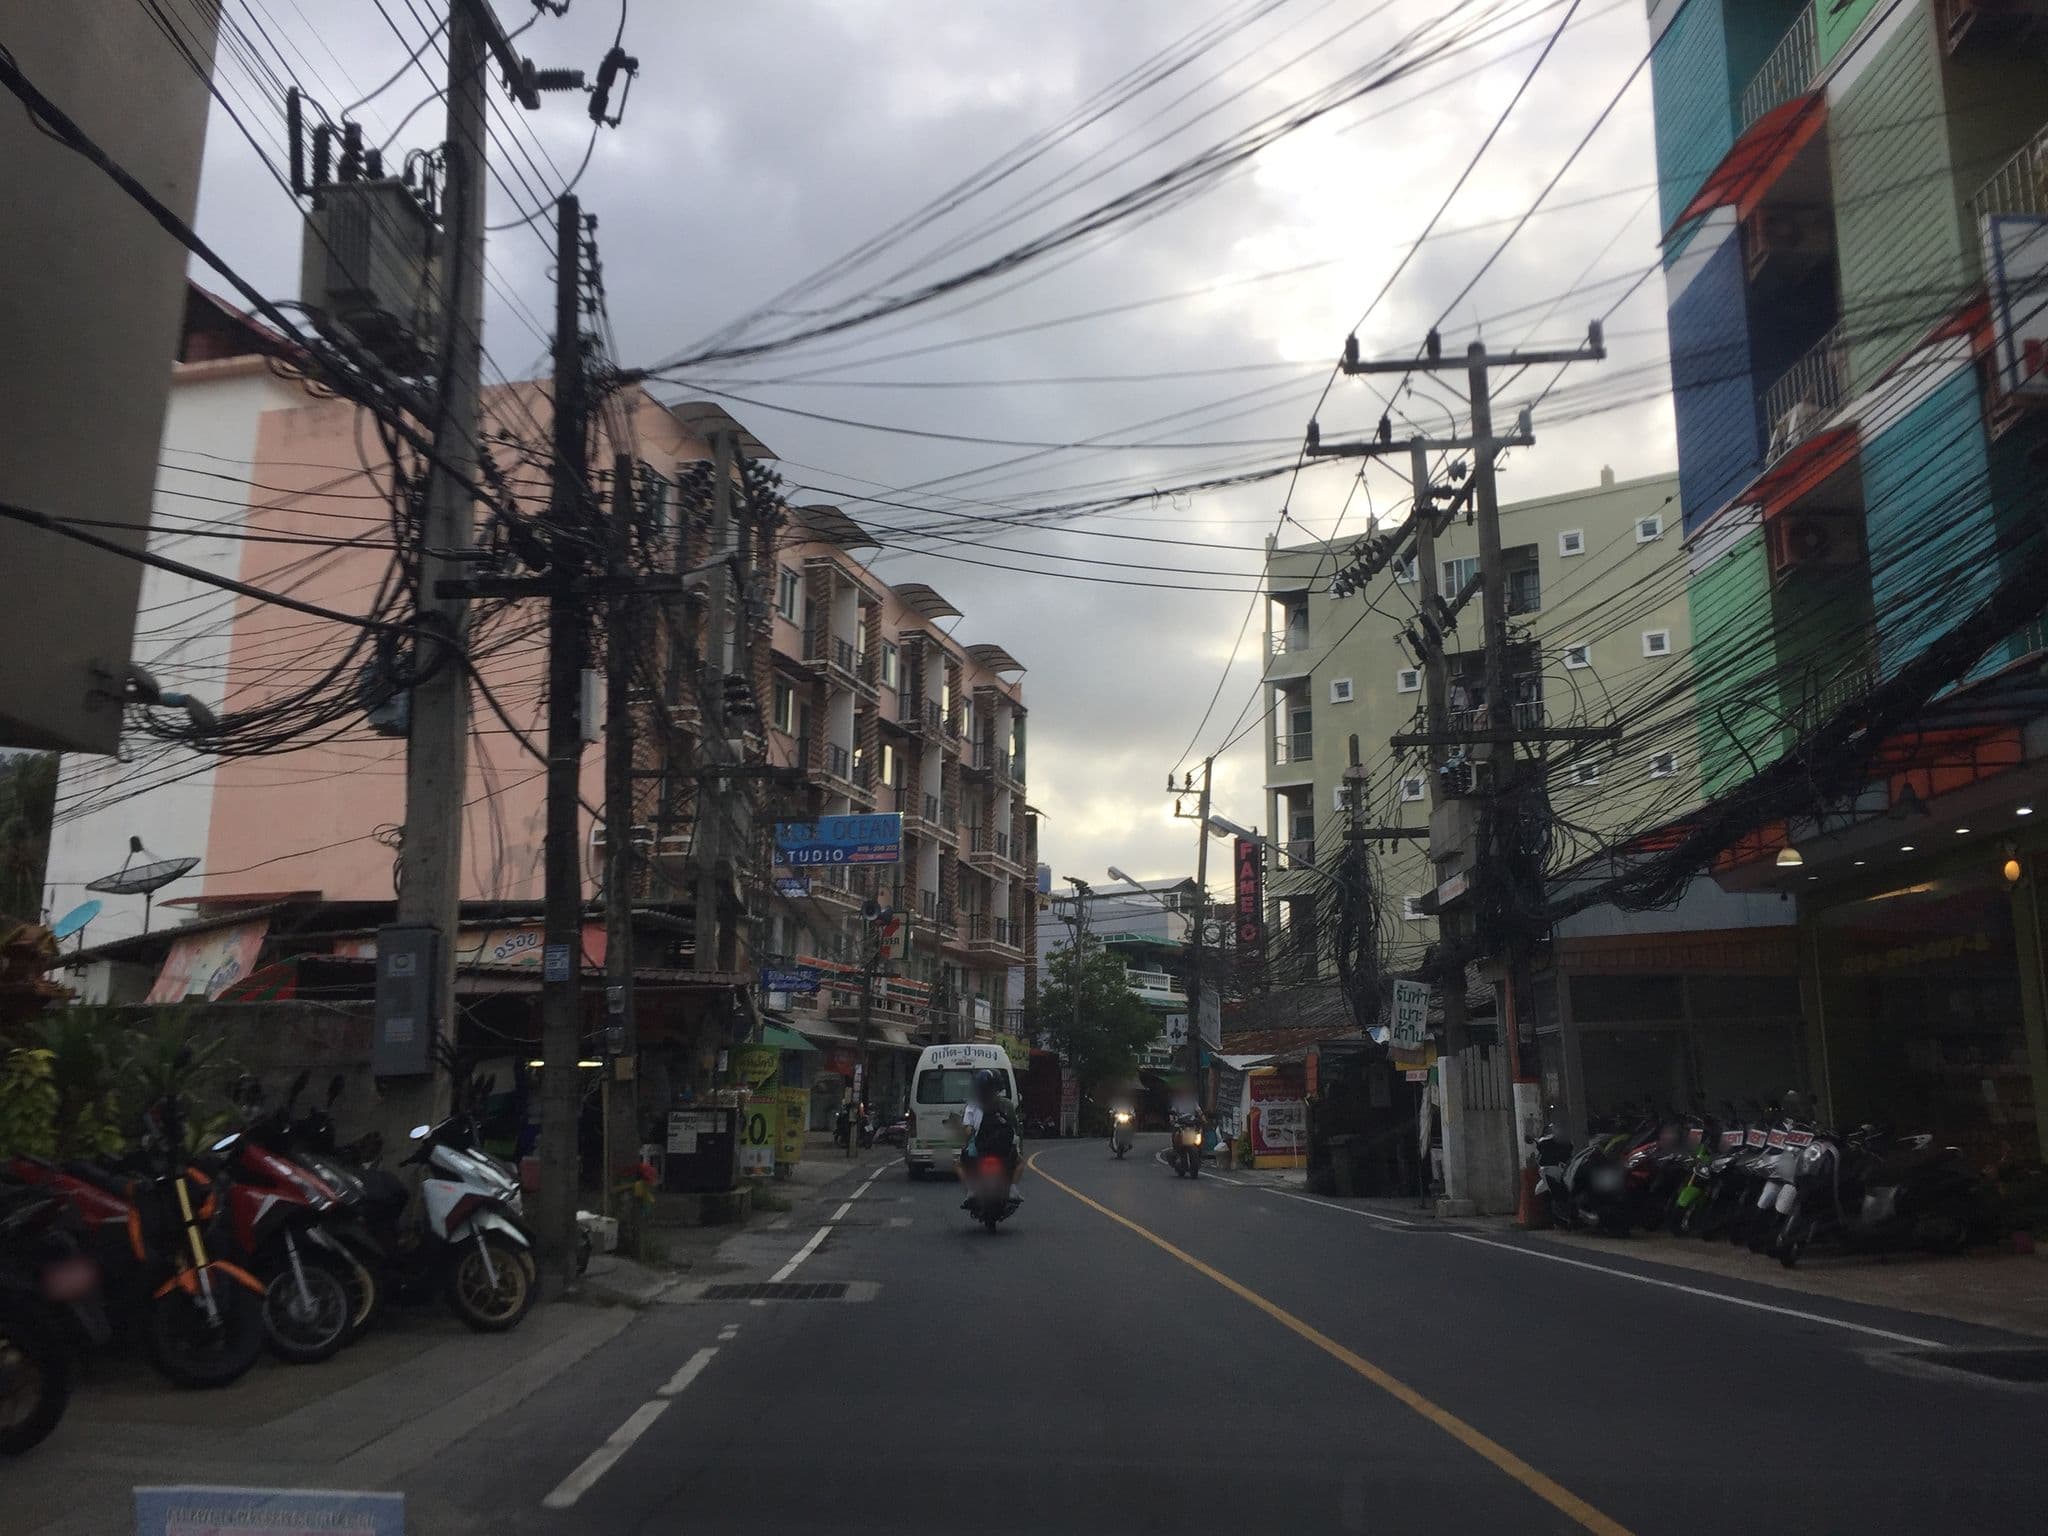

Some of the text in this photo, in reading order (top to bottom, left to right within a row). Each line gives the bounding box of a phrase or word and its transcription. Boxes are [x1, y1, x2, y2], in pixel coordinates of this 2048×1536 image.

[833, 818, 896, 841] OCEAN
[494, 930, 538, 960] อร่อย
[1399, 1006, 1423, 1022] เบาะ
